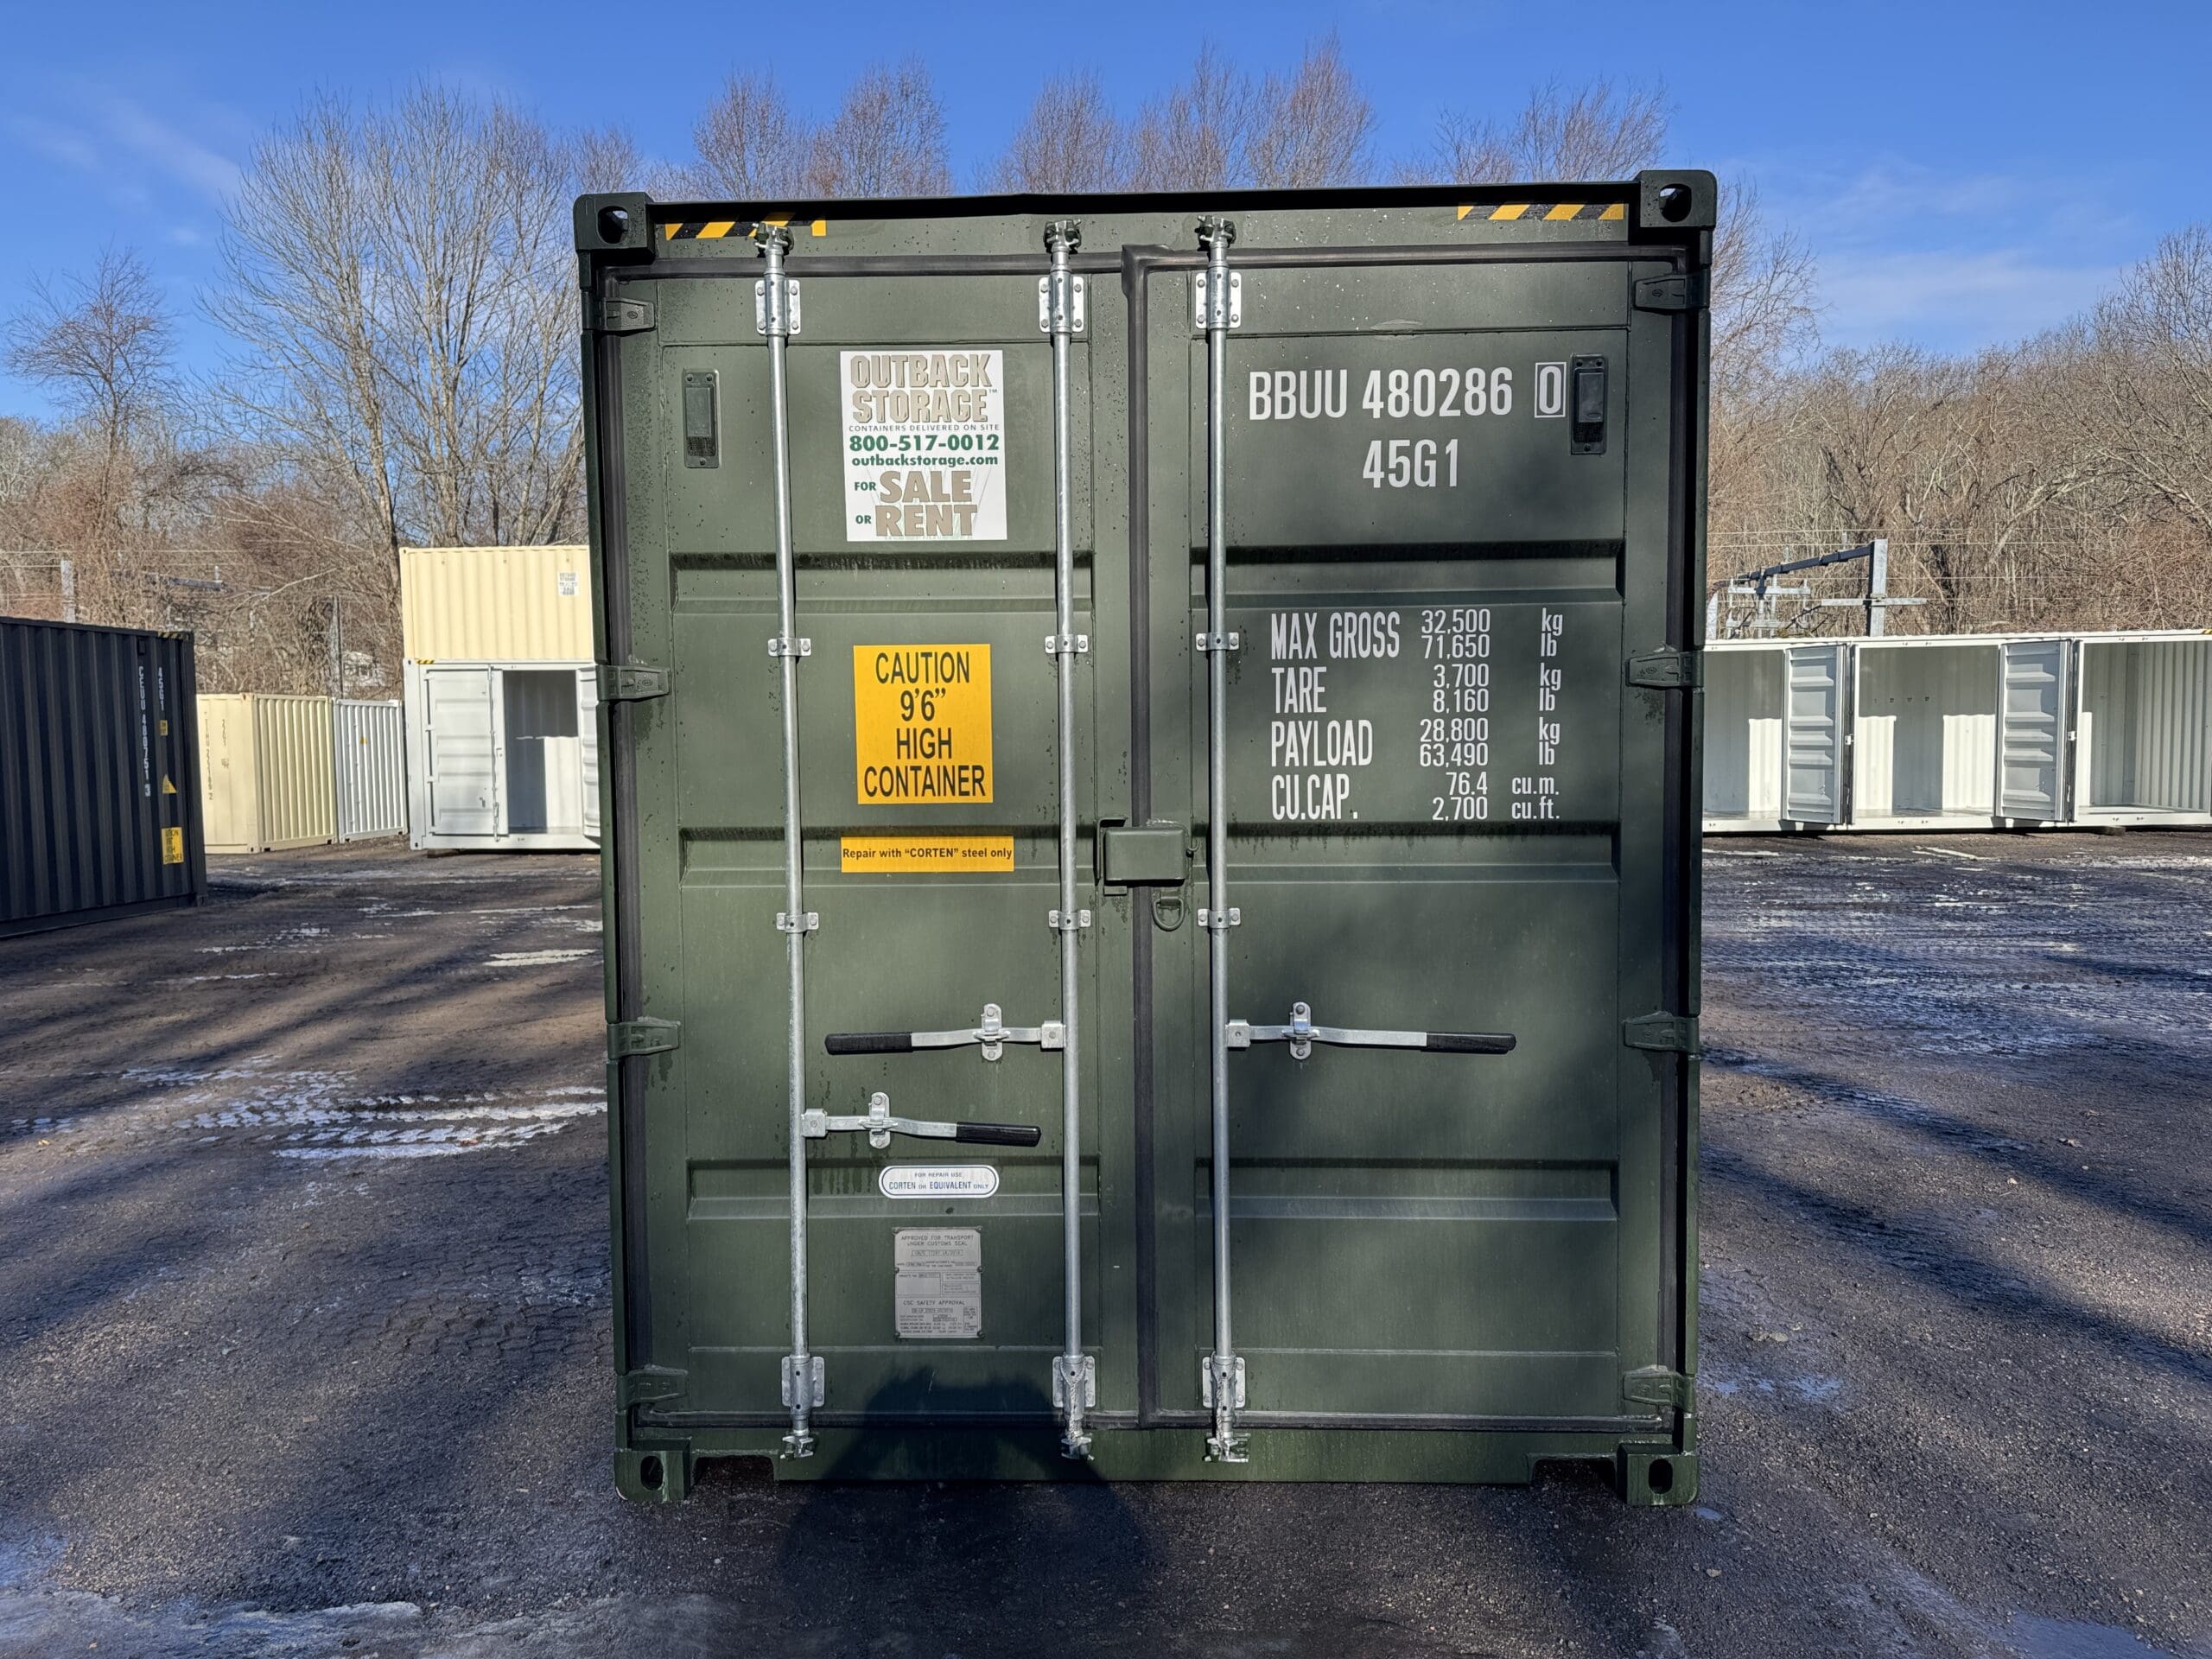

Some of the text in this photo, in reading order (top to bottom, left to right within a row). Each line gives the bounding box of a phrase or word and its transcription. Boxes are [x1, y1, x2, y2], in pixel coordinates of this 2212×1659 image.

[850, 353, 992, 388] OUTBACK
[852, 389, 988, 423] STORAGE
[1249, 365, 1561, 421] BBUU 480286 0
[849, 434, 1000, 451] 800-517-0012
[852, 454, 998, 467] outbackstorage.com
[1362, 439, 1458, 488] 45G1
[855, 470, 972, 503] FOR SALE
[855, 505, 978, 537] OR RENT
[1271, 611, 1401, 660] MAX GROSS
[1421, 607, 1563, 636] 32,500 kg
[1421, 632, 1557, 660] 71,650 lb
[875, 652, 970, 683] CAUTION
[1433, 662, 1561, 691] 3,700 kg
[1271, 666, 1327, 714] TARE
[1433, 688, 1555, 714] 8,160 lb
[896, 728, 952, 760] HIGH
[1271, 719, 1373, 767] PAYLOAD
[1420, 716, 1560, 745] 28,800 kg
[1420, 742, 1554, 768] 63,490 lb
[864, 765, 986, 798] CONTAINER
[1446, 772, 1560, 796] 76.4 cu.m.
[1432, 796, 1560, 821] 2,700 cu.ft.
[842, 848, 875, 860] Repair
[879, 848, 901, 858] with
[962, 848, 987, 858] steel
[990, 848, 1012, 860] only
[888, 1181, 916, 1190] CORTEN
[930, 1181, 971, 1190] EQUIVALENT
